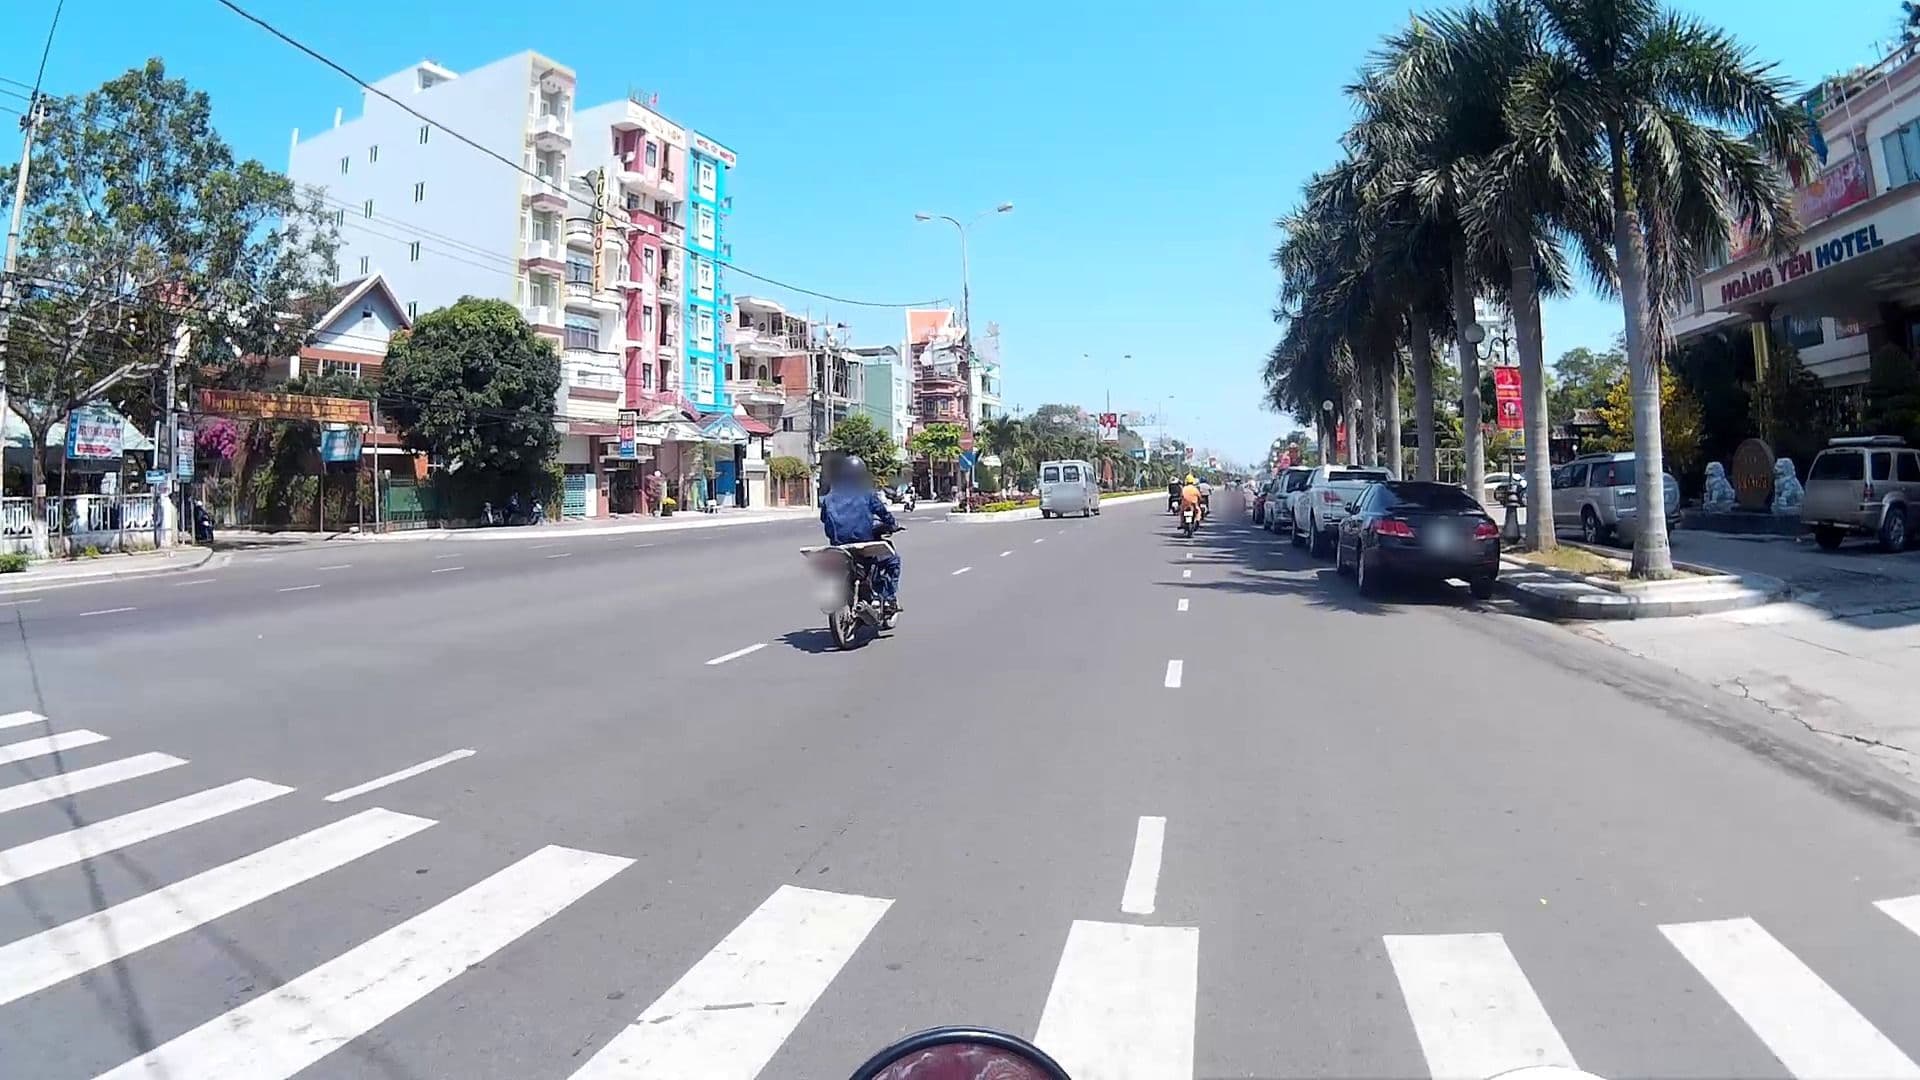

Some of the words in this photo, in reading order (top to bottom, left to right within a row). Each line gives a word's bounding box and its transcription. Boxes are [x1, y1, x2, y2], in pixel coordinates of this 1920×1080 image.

[594, 224, 603, 293] HOTEL
[1721, 270, 1774, 303] HOÀNG
[1816, 224, 1883, 268] HOTEL
